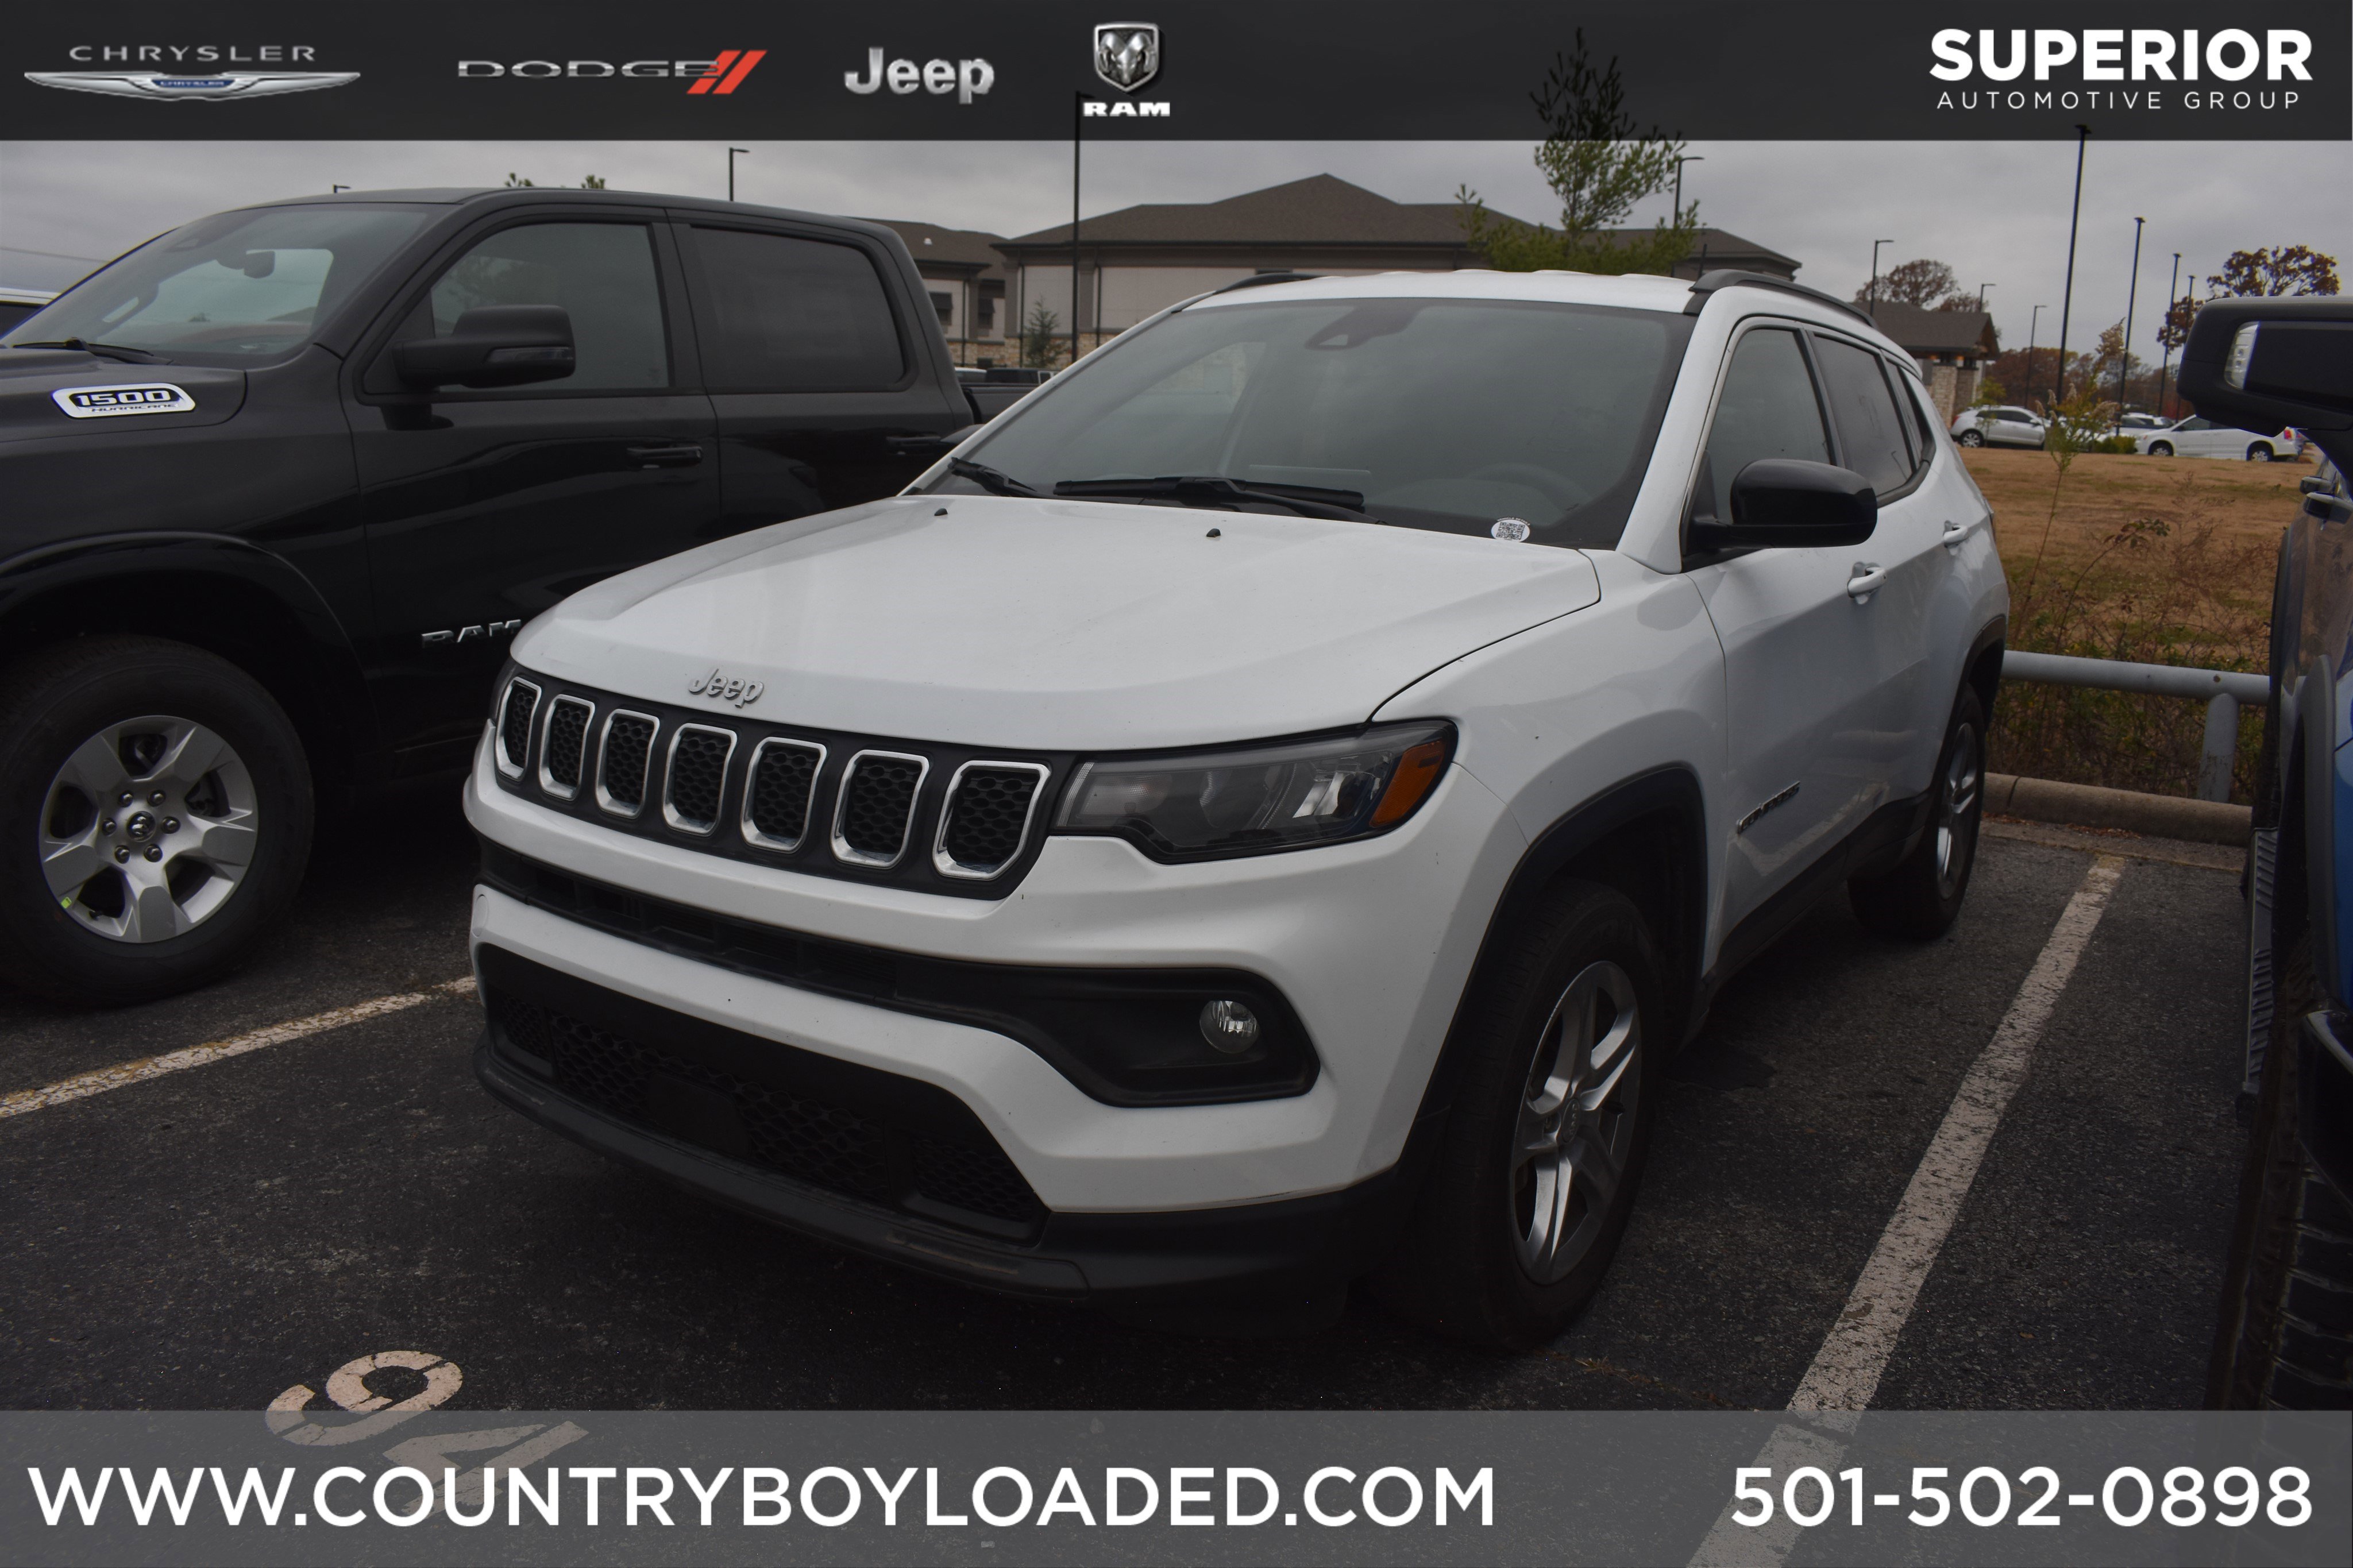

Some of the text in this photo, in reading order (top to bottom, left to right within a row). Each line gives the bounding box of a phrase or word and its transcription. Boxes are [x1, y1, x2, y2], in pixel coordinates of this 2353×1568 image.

[76, 390, 172, 406] 1500
[91, 404, 177, 412] HURRICANE
[421, 619, 522, 648] RAM
[689, 668, 765, 709] Jeep
